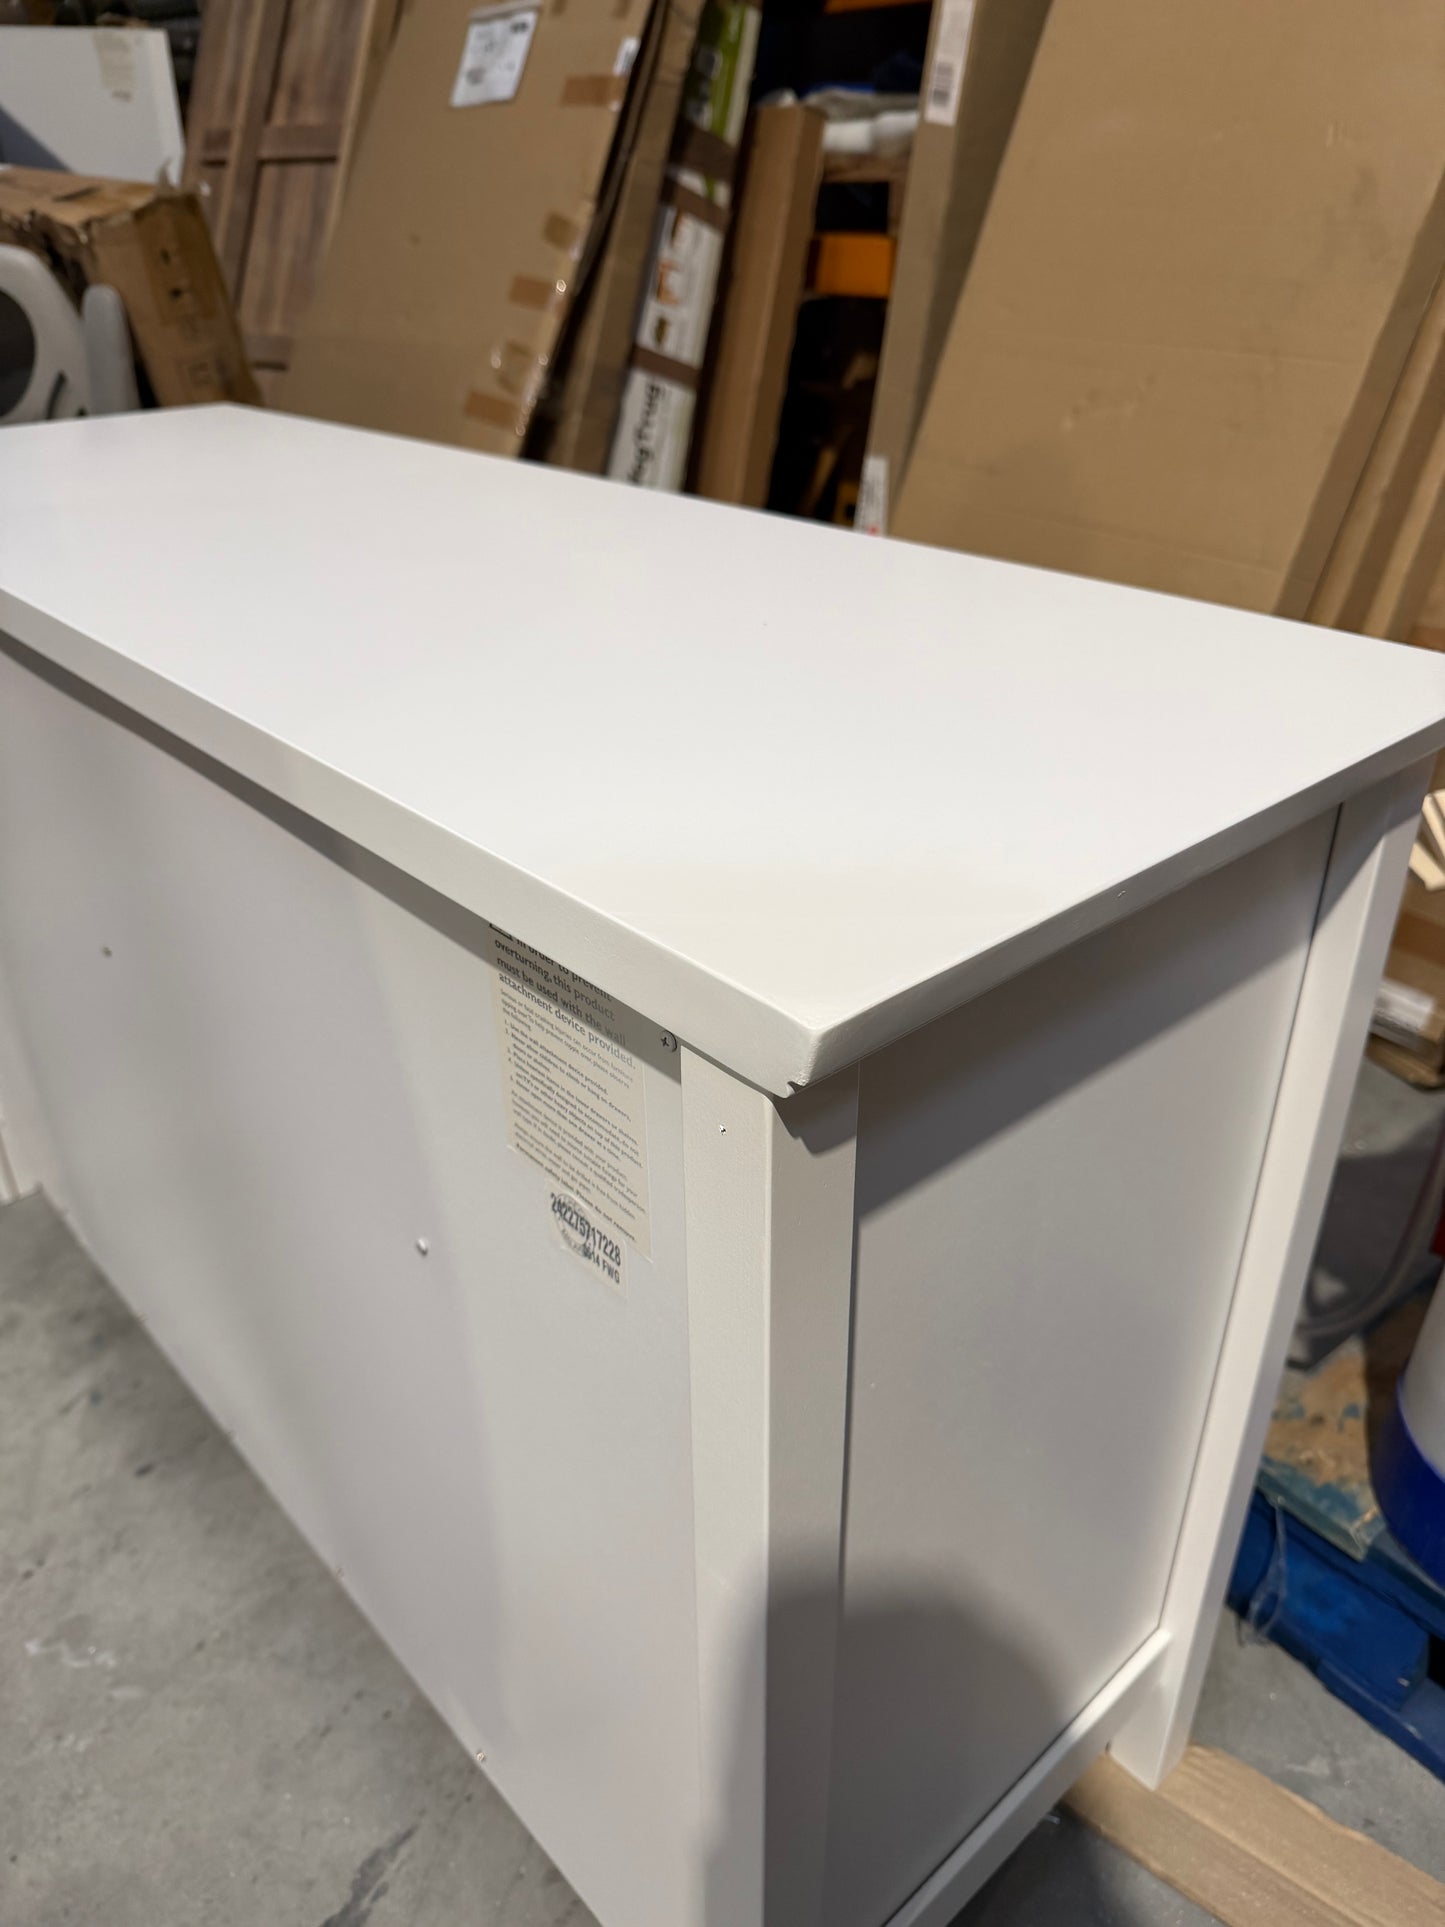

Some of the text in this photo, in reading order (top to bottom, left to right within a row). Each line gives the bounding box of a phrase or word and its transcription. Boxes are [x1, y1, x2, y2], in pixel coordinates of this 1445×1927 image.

[496, 957, 626, 1046] must be used with the wall
[498, 969, 635, 1069] attachment device provided.
[553, 975, 572, 993] this
[573, 989, 614, 1021] product
